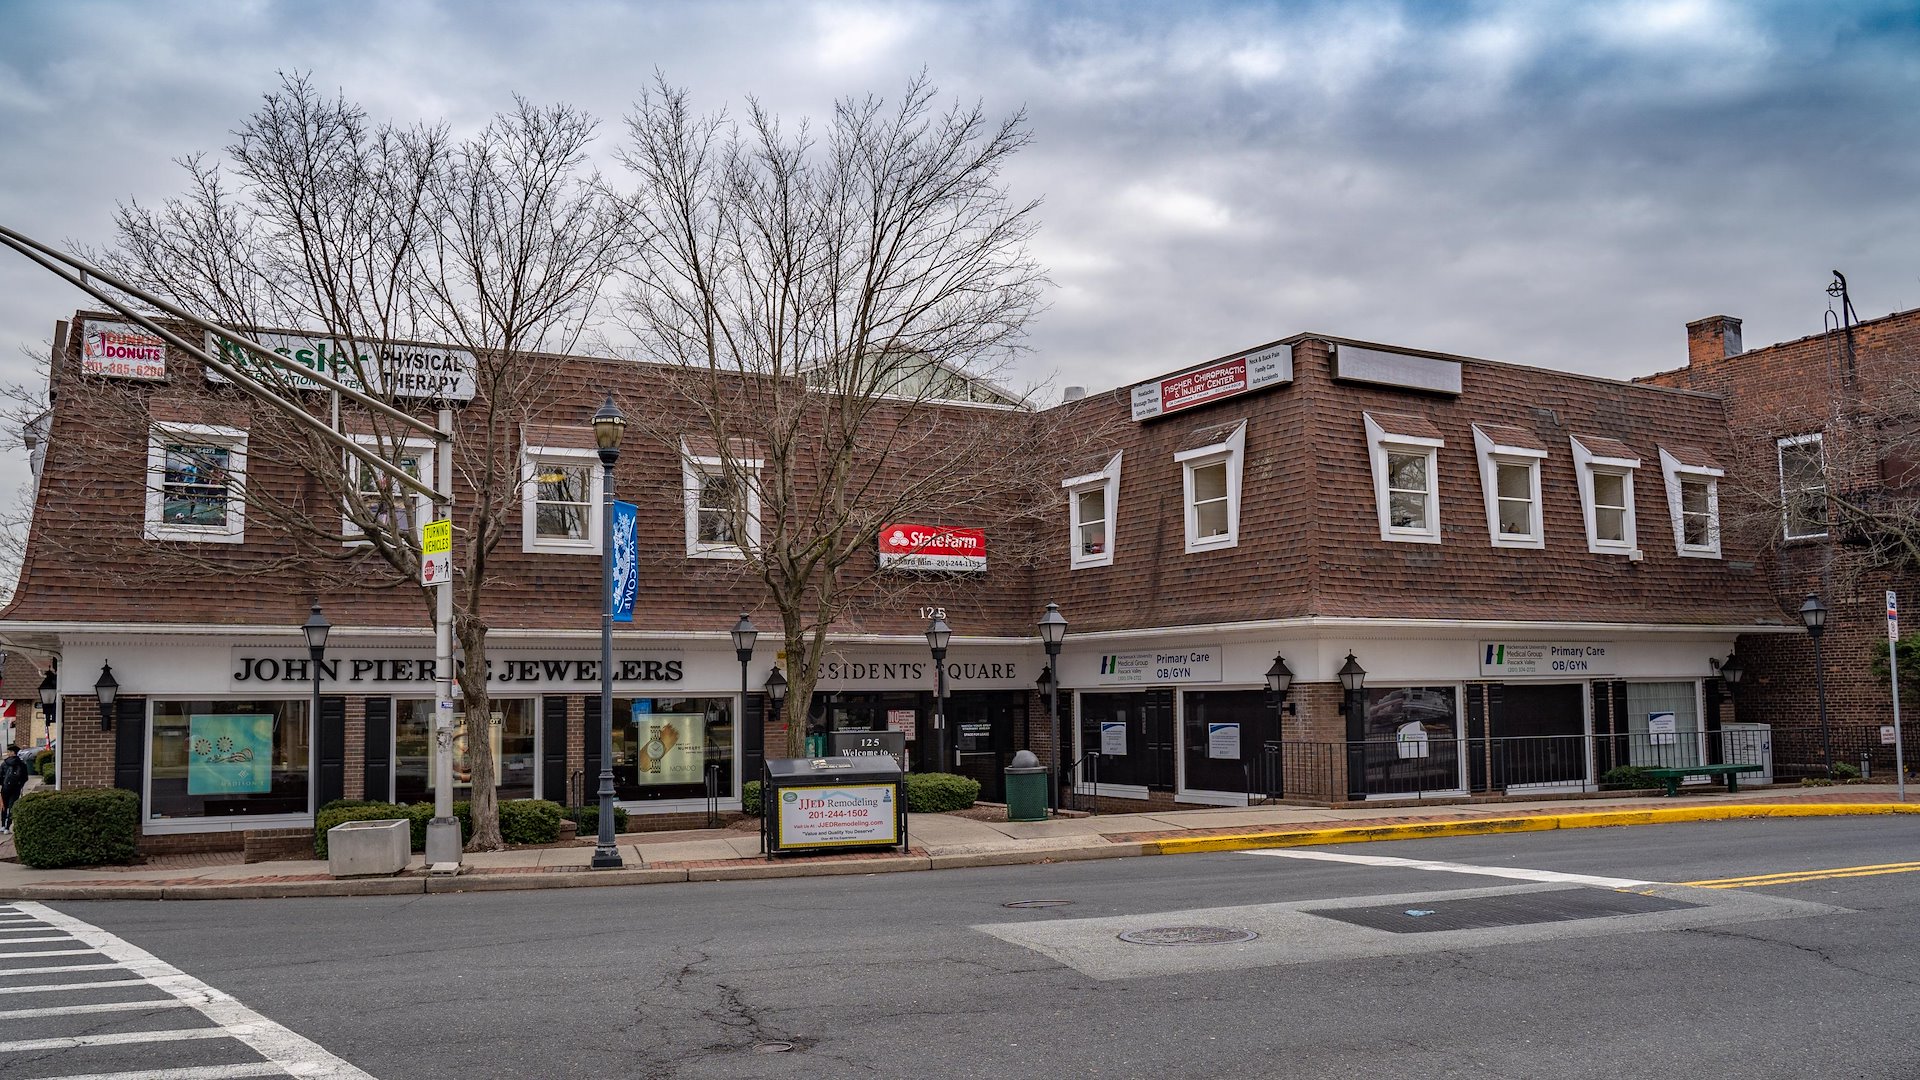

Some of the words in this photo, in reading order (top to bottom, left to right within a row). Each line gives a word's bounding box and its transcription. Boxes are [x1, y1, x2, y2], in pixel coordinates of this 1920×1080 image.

[106, 346, 161, 361] DONUTS
[382, 351, 462, 372] PHYSICAL
[1255, 366, 1266, 374] Family
[383, 372, 460, 392] THERAPY
[1164, 378, 1192, 396] FISCHER
[1194, 365, 1245, 383] CHIROPRACTIC
[1174, 391, 1179, 399] &
[1181, 384, 1206, 397] INJURY
[1206, 375, 1235, 389] CENTER
[426, 524, 448, 539] TURNING
[425, 538, 449, 552] VEHICLES
[887, 557, 915, 567] Rard
[624, 540, 637, 610] WELCOME
[919, 607, 947, 620] 125
[1156, 654, 1188, 664] Primary
[1190, 652, 1210, 662] Care
[1551, 646, 1583, 658] Primary
[1586, 646, 1605, 656] Care
[234, 658, 342, 681] JOHN
[349, 658, 491, 681] PIER
[1552, 660, 1588, 672] OB/GYN
[1156, 668, 1191, 679] OB/GYN
[888, 710, 900, 724] NO
[860, 738, 880, 747] 125
[842, 749, 878, 757] Welcome
[798, 799, 825, 810] JJED
[827, 797, 878, 808] Remodeling
[808, 809, 868, 819] 201-244-1502
[818, 820, 884, 828] JJEDRemodeling.com
